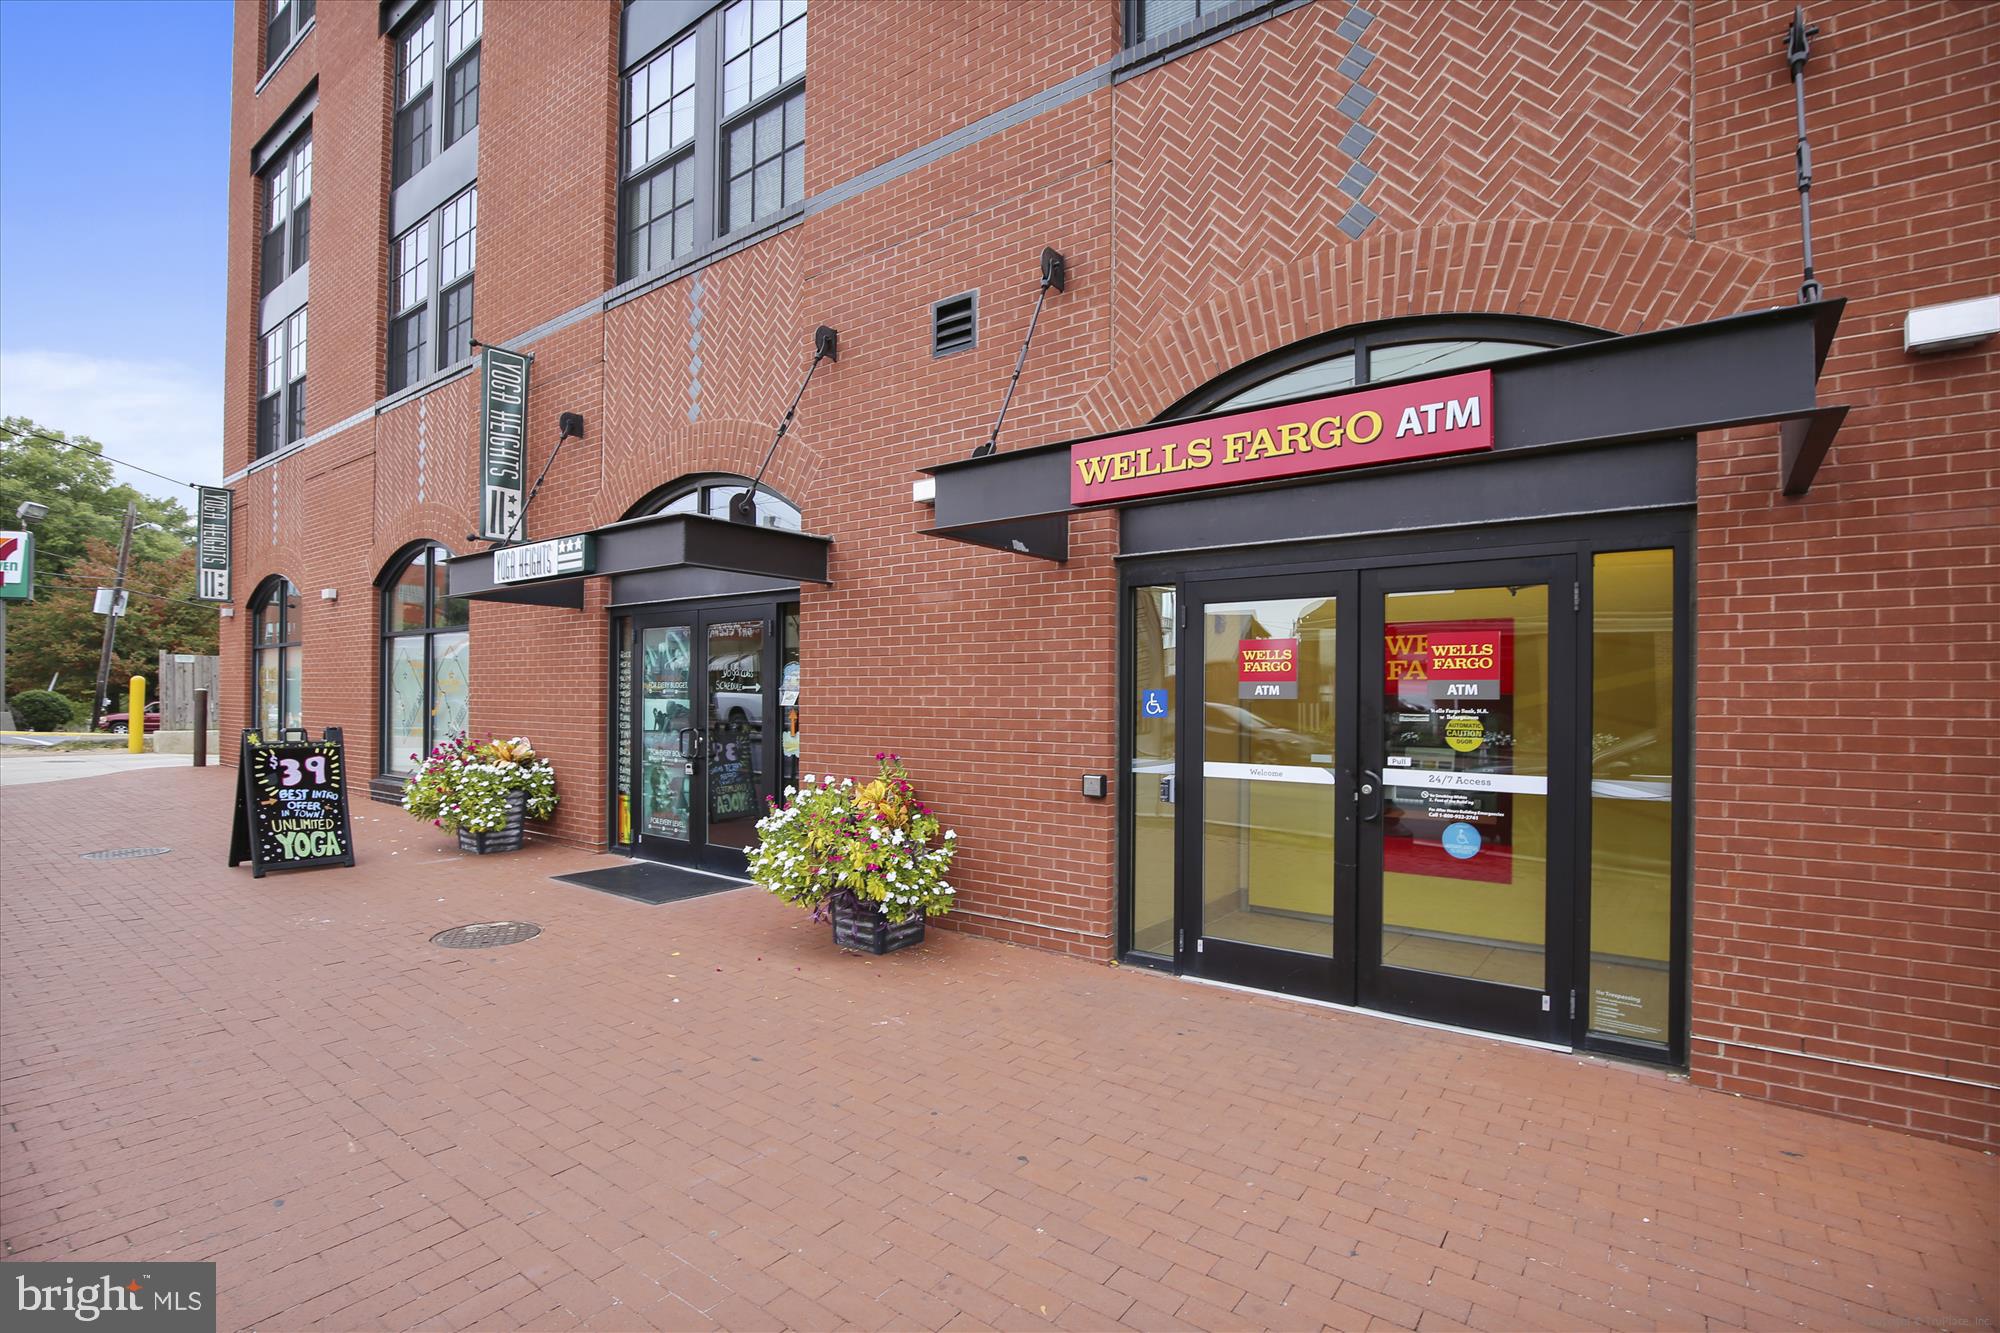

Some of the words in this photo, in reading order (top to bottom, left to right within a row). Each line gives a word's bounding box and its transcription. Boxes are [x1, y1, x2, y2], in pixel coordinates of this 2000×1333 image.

[490, 361, 522, 405] YOGA
[489, 409, 521, 481] HEIGHTS
[1076, 438, 1213, 486] WELLS
[1222, 410, 1384, 464] FARGO
[1396, 396, 1481, 438] ATM
[204, 494, 228, 520] YOGA
[203, 523, 227, 565] HEIGHTS
[497, 550, 516, 582] YOGA
[518, 543, 552, 578] HEIGHTS
[1242, 649, 1293, 661] WELLS
[1431, 644, 1494, 657] WELLS
[1243, 661, 1292, 673] FARGO
[1432, 657, 1494, 670] FARGO
[1254, 685, 1280, 696] ATM
[1446, 684, 1478, 696] ATM
[1249, 768, 1284, 778] Welcome
[1428, 774, 1453, 785] 24/7
[1455, 776, 1492, 787] Access
[279, 789, 309, 801] BEST
[312, 790, 339, 801] INTRO
[287, 801, 321, 811] OFFER
[295, 809, 325, 818] TOWN!
[271, 818, 334, 832] UNLIMITED
[275, 831, 341, 860] YOGA
